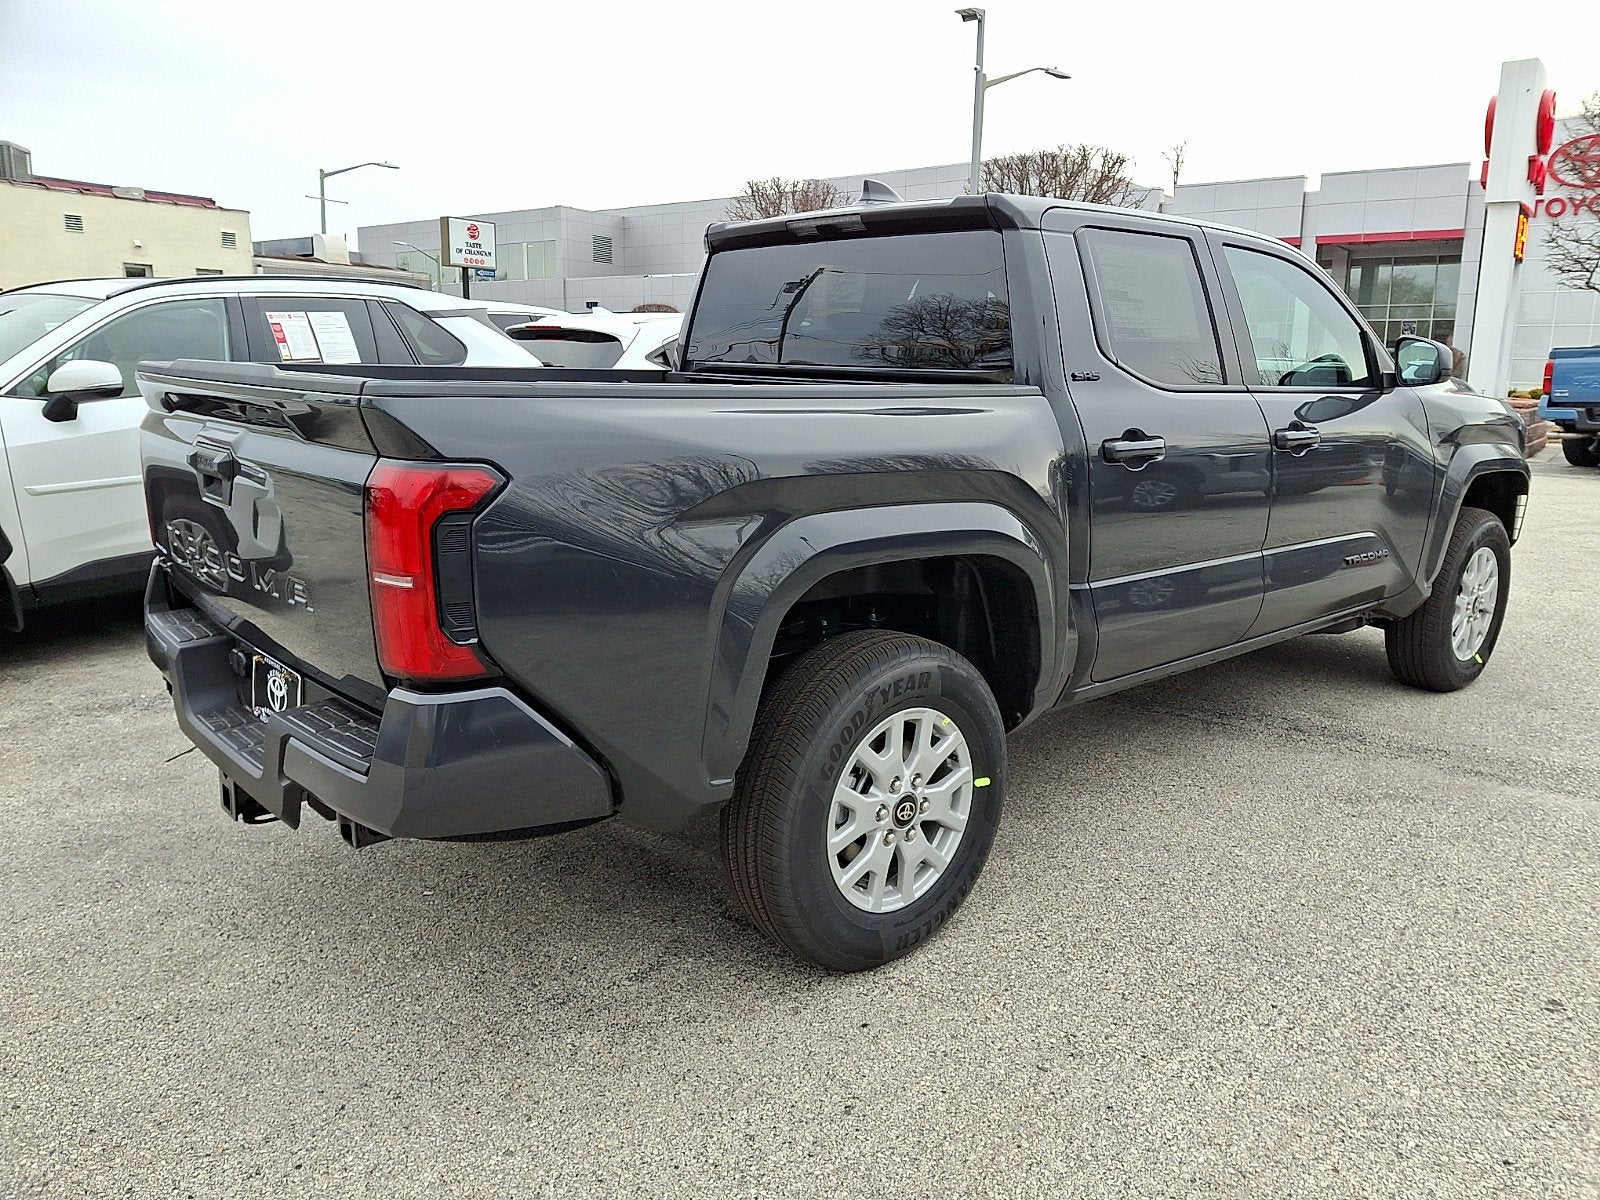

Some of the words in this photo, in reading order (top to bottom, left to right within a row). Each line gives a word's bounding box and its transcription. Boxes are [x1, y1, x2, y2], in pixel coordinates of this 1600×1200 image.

[1071, 371, 1100, 382] SR5
[1344, 549, 1389, 565] TACOMA
[821, 671, 931, 780] GOODYEAR
